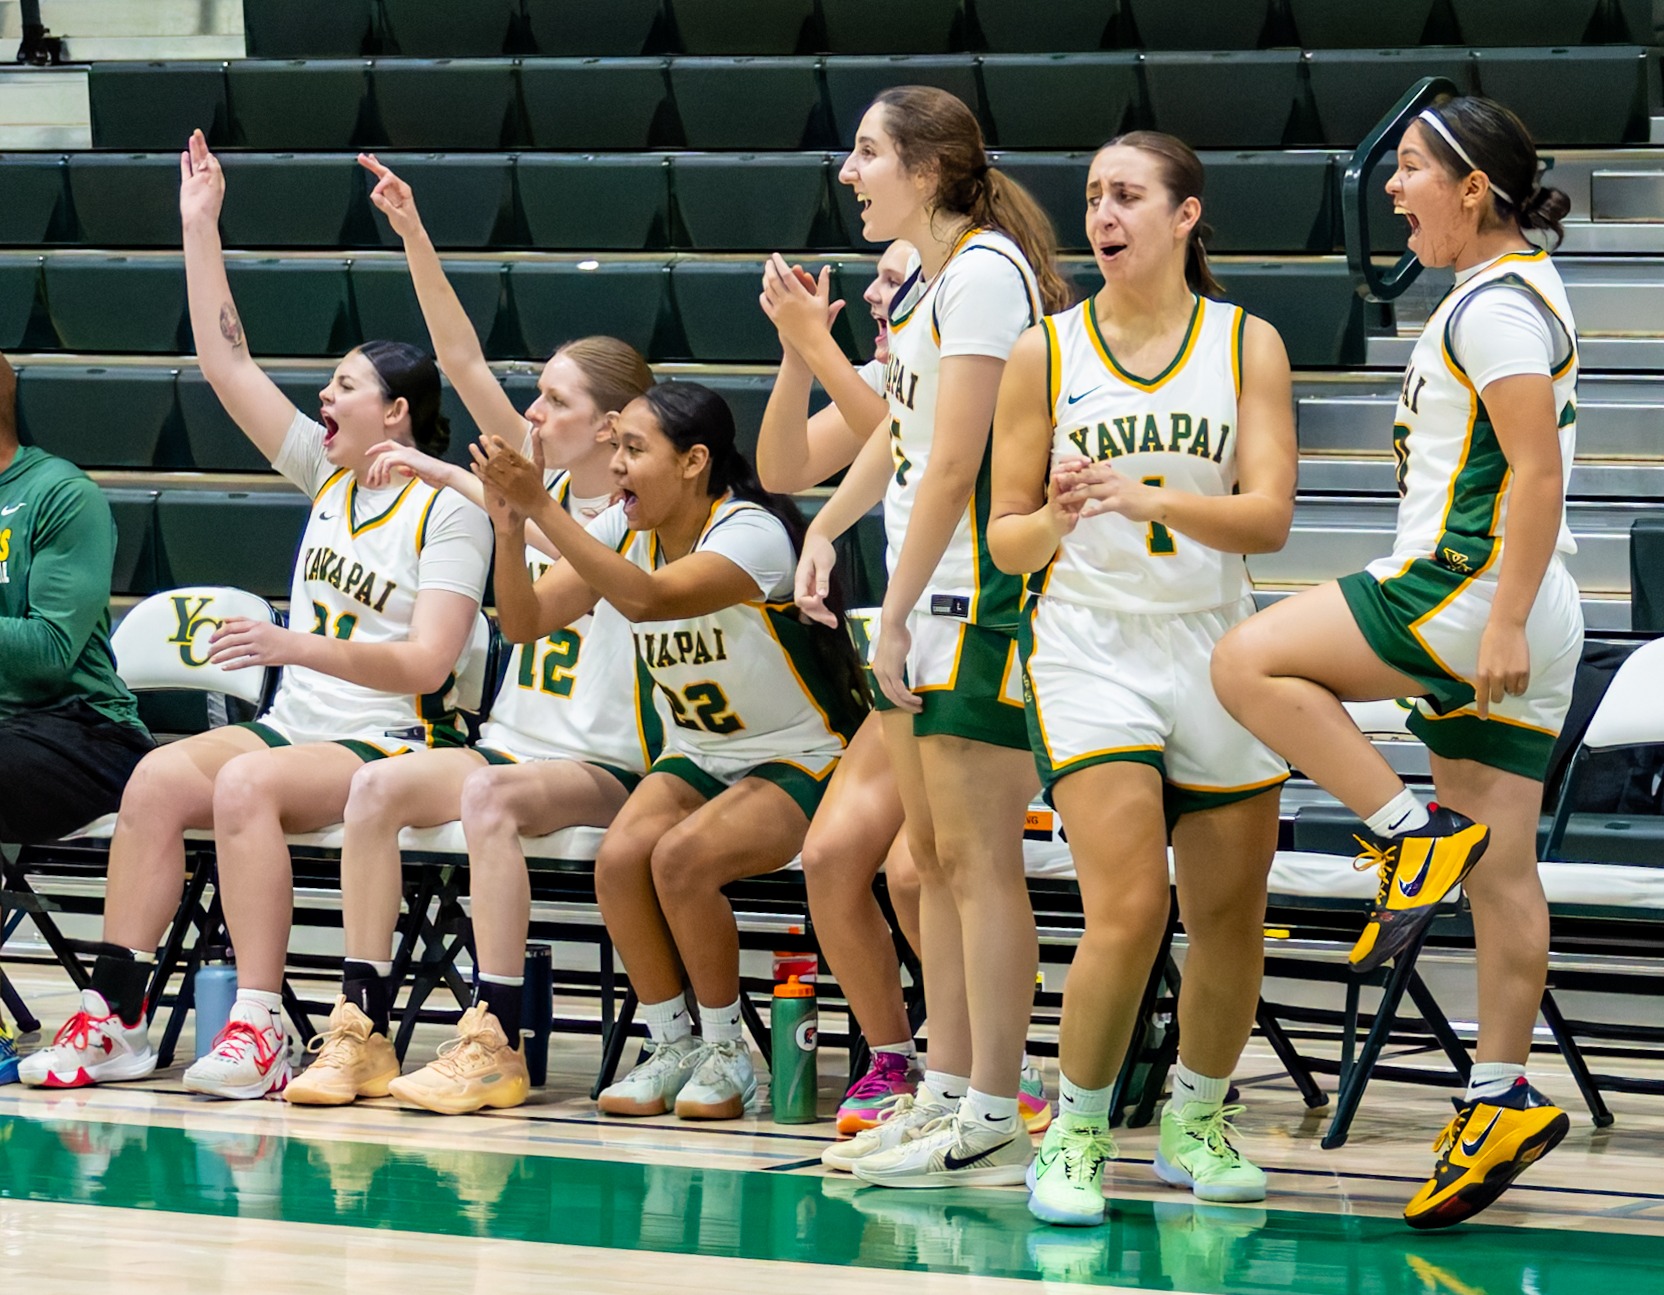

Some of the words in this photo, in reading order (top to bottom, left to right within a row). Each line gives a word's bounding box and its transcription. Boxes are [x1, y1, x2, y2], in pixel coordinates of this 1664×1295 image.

[1067, 412, 1232, 466] YAVAPAI
[1141, 475, 1178, 556] 1
[517, 627, 584, 700] 12
